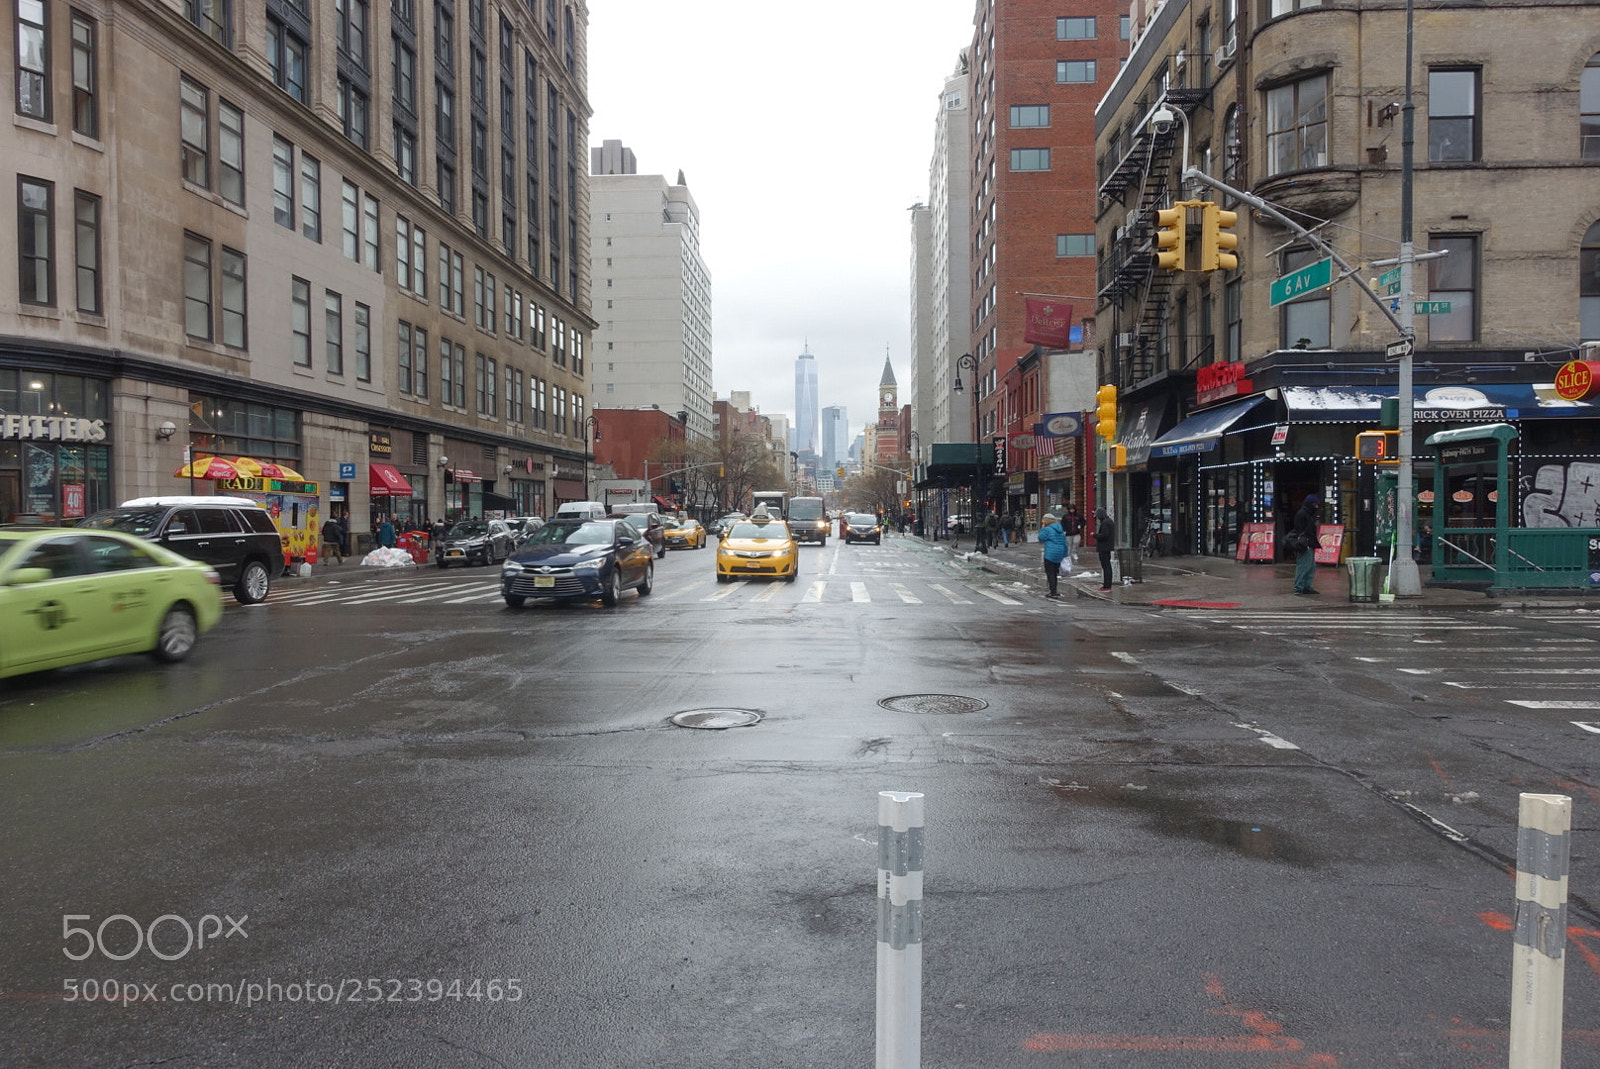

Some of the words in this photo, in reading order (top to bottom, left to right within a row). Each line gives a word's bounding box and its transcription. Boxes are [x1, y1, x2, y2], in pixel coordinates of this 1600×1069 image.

[1285, 279, 1292, 296] 6
[1389, 285, 1394, 295] 6
[1415, 303, 1424, 314] W
[1428, 303, 1440, 313] 14
[1558, 370, 1589, 390] SLICE
[1413, 410, 1439, 419] RICK
[1440, 410, 1470, 418] OVEN
[1473, 409, 1504, 418] PIZZA
[1272, 431, 1287, 441] ATM
[1376, 440, 1384, 456] 3
[1589, 539, 1600, 550] S
